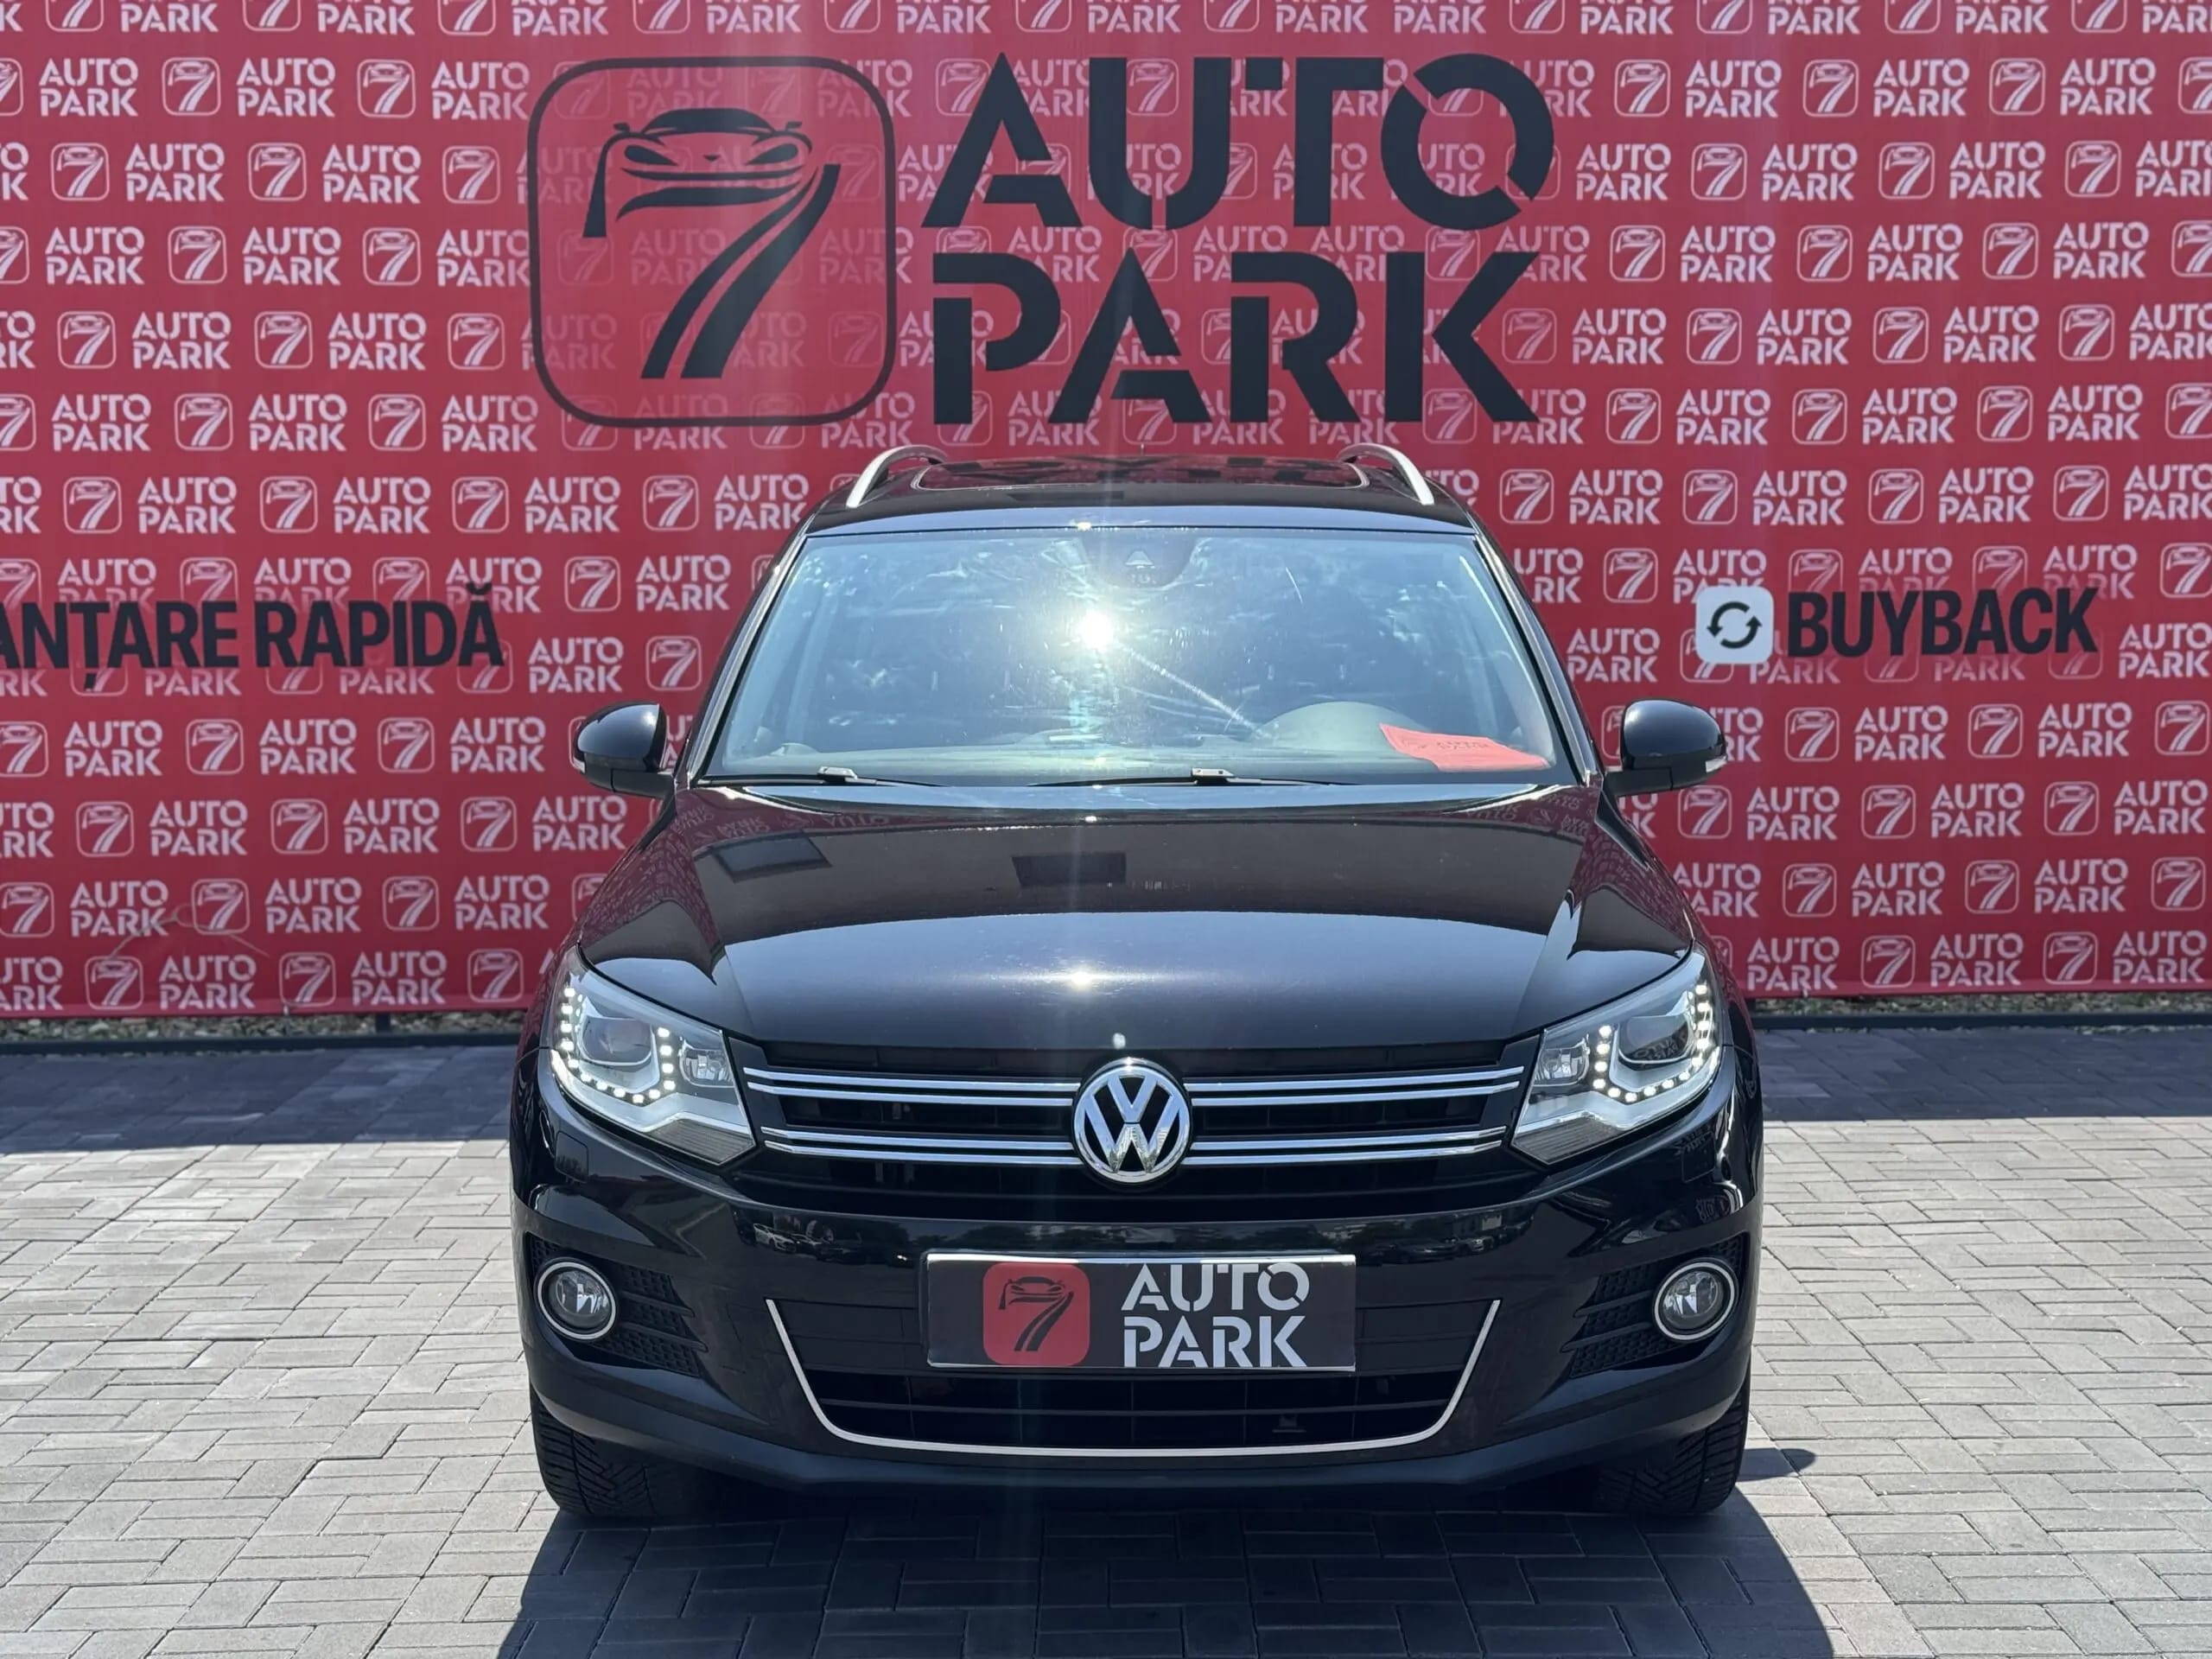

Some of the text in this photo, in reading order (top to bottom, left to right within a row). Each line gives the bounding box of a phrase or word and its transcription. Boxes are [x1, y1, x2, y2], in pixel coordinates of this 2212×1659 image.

[121, 3, 219, 32] PARK
[318, 3, 415, 35] PARK
[513, 7, 607, 35] PARK
[708, 4, 801, 33] PARK
[898, 5, 990, 33] PARK
[1089, 5, 1180, 32] PARK
[1276, 4, 1368, 33] PARK
[1395, 5, 1485, 33] PARK
[1581, 6, 1673, 35] PARK
[1769, 6, 1860, 35] PARK
[1956, 5, 2049, 34] PARK
[39, 58, 138, 86] AUTO
[237, 58, 335, 86] AUTO
[431, 61, 529, 90] AUTO
[1686, 60, 1782, 88] AUTO
[1873, 59, 1969, 87] AUTO
[2060, 58, 2156, 86] AUTO
[41, 88, 138, 117] PARK
[238, 87, 334, 118] PARK
[432, 91, 527, 119] PARK
[1686, 89, 1778, 118] PARK
[1874, 88, 1967, 117] PARK
[2060, 86, 2152, 115] PARK
[921, 53, 1554, 230] AUTO
[1949, 141, 2045, 169] AUTO
[125, 143, 225, 172] AUTO
[322, 144, 421, 174] AUTO
[1576, 143, 1671, 171] AUTO
[1763, 143, 1858, 171] AUTO
[127, 173, 224, 201] PARK
[323, 174, 420, 204] PARK
[1577, 173, 1668, 200] PARK
[1763, 173, 1854, 201] PARK
[1949, 170, 2043, 199] PARK
[45, 226, 144, 255] AUTO
[242, 227, 341, 256] AUTO
[436, 230, 528, 257] AUTO
[1007, 226, 1102, 252] AUTO
[1194, 226, 1287, 251] AUTO
[1311, 226, 1404, 251] AUTO
[1496, 226, 1590, 252] AUTO
[1681, 226, 1776, 253] AUTO
[1868, 224, 1963, 252] AUTO
[2054, 221, 2149, 250] AUTO
[47, 256, 144, 284] PARK
[244, 256, 340, 285] PARK
[437, 257, 530, 286] PARK
[1681, 254, 1772, 283] PARK
[1868, 252, 1960, 282] PARK
[2054, 251, 2145, 279] PARK
[132, 312, 231, 340] AUTO
[328, 313, 427, 340] AUTO
[1573, 308, 1666, 335] AUTO
[1757, 308, 1852, 336] AUTO
[1943, 305, 2039, 334] AUTO
[933, 247, 1540, 424] PARK
[1944, 334, 2036, 363] PARK
[133, 340, 231, 369] PARK
[329, 341, 425, 370] PARK
[1573, 337, 1663, 364] PARK
[1758, 337, 1848, 365] PARK
[52, 394, 151, 422] AUTO
[249, 394, 347, 422] AUTO
[442, 396, 537, 422] AUTO
[1676, 390, 1770, 416] AUTO
[1863, 387, 1957, 416] AUTO
[2048, 385, 2143, 412] AUTO
[53, 423, 150, 451] PARK
[250, 423, 346, 451] PARK
[442, 423, 537, 451] PARK
[823, 416, 916, 449] PARK
[1494, 417, 1583, 444] PARK
[1677, 417, 1768, 445] PARK
[1863, 416, 1955, 444] PARK
[2048, 413, 2140, 441] PARK
[138, 477, 237, 505] AUTO
[334, 477, 431, 505] AUTO
[524, 476, 620, 504] AUTO
[715, 474, 809, 501] AUTO
[1569, 469, 1662, 496] AUTO
[1753, 470, 1847, 497] AUTO
[1939, 467, 2034, 494] AUTO
[139, 505, 236, 534] PARK
[334, 505, 429, 533] PARK
[525, 505, 619, 533] PARK
[1570, 498, 1660, 524] PARK
[1753, 498, 1844, 525] PARK
[1939, 495, 2031, 523] PARK
[2124, 493, 2212, 520] PARK
[254, 557, 352, 585] AUTO
[446, 557, 542, 584] AUTO
[636, 555, 730, 582] AUTO
[1673, 550, 1766, 576] AUTO
[1859, 547, 1952, 575] AUTO
[2044, 544, 2138, 571] AUTO
[58, 558, 156, 586] AUTO
[637, 583, 728, 611] PARK
[257, 582, 505, 667] RAPIDĂ
[1787, 588, 2098, 657] BUYBACK
[2120, 623, 2212, 650] AUTO
[529, 637, 623, 664] AUTO
[1567, 628, 1660, 654] AUTO
[1566, 652, 1656, 685] PARK
[2119, 651, 2209, 678] PARK
[530, 665, 621, 693] PARK
[1854, 705, 1948, 733] AUTO
[2038, 702, 2132, 729] AUTO
[64, 720, 162, 748] AUTO
[259, 719, 357, 746] AUTO
[450, 717, 545, 744] AUTO
[2038, 730, 2129, 757] PARK
[261, 747, 356, 774] PARK
[451, 745, 544, 772] PARK
[1855, 733, 1945, 760] PARK
[66, 748, 162, 777] PARK
[1747, 786, 1840, 812] AUTO
[1931, 783, 2024, 810] AUTO
[2114, 779, 2208, 806] AUTO
[149, 800, 247, 827] AUTO
[344, 798, 439, 825] AUTO
[532, 796, 626, 823] AUTO
[1932, 810, 2021, 837] PARK
[2114, 807, 2205, 835] PARK
[345, 826, 438, 853] PARK
[534, 823, 625, 850] PARK
[1747, 814, 1837, 840] PARK
[151, 828, 246, 855] PARK
[1852, 861, 1945, 889] AUTO
[2035, 858, 2128, 885] AUTO
[70, 880, 168, 908] AUTO
[265, 878, 361, 905] AUTO
[454, 875, 550, 901] AUTO
[2035, 886, 2125, 912] PARK
[456, 902, 548, 929] PARK
[1853, 889, 1942, 917] PARK
[71, 909, 168, 937] PARK
[266, 906, 360, 933] PARK
[1748, 937, 1839, 963] AUTO
[1931, 933, 2023, 959] AUTO
[2113, 931, 2207, 956] AUTO
[160, 955, 256, 982] AUTO
[352, 950, 446, 976] AUTO
[1931, 961, 2020, 987] PARK
[2113, 958, 2204, 983] PARK
[353, 978, 445, 1005] PARK
[1748, 964, 1838, 991] PARK
[161, 983, 254, 1009] PARK
[1121, 1262, 1310, 1312] AUTO
[1124, 1315, 1308, 1367] PARK
